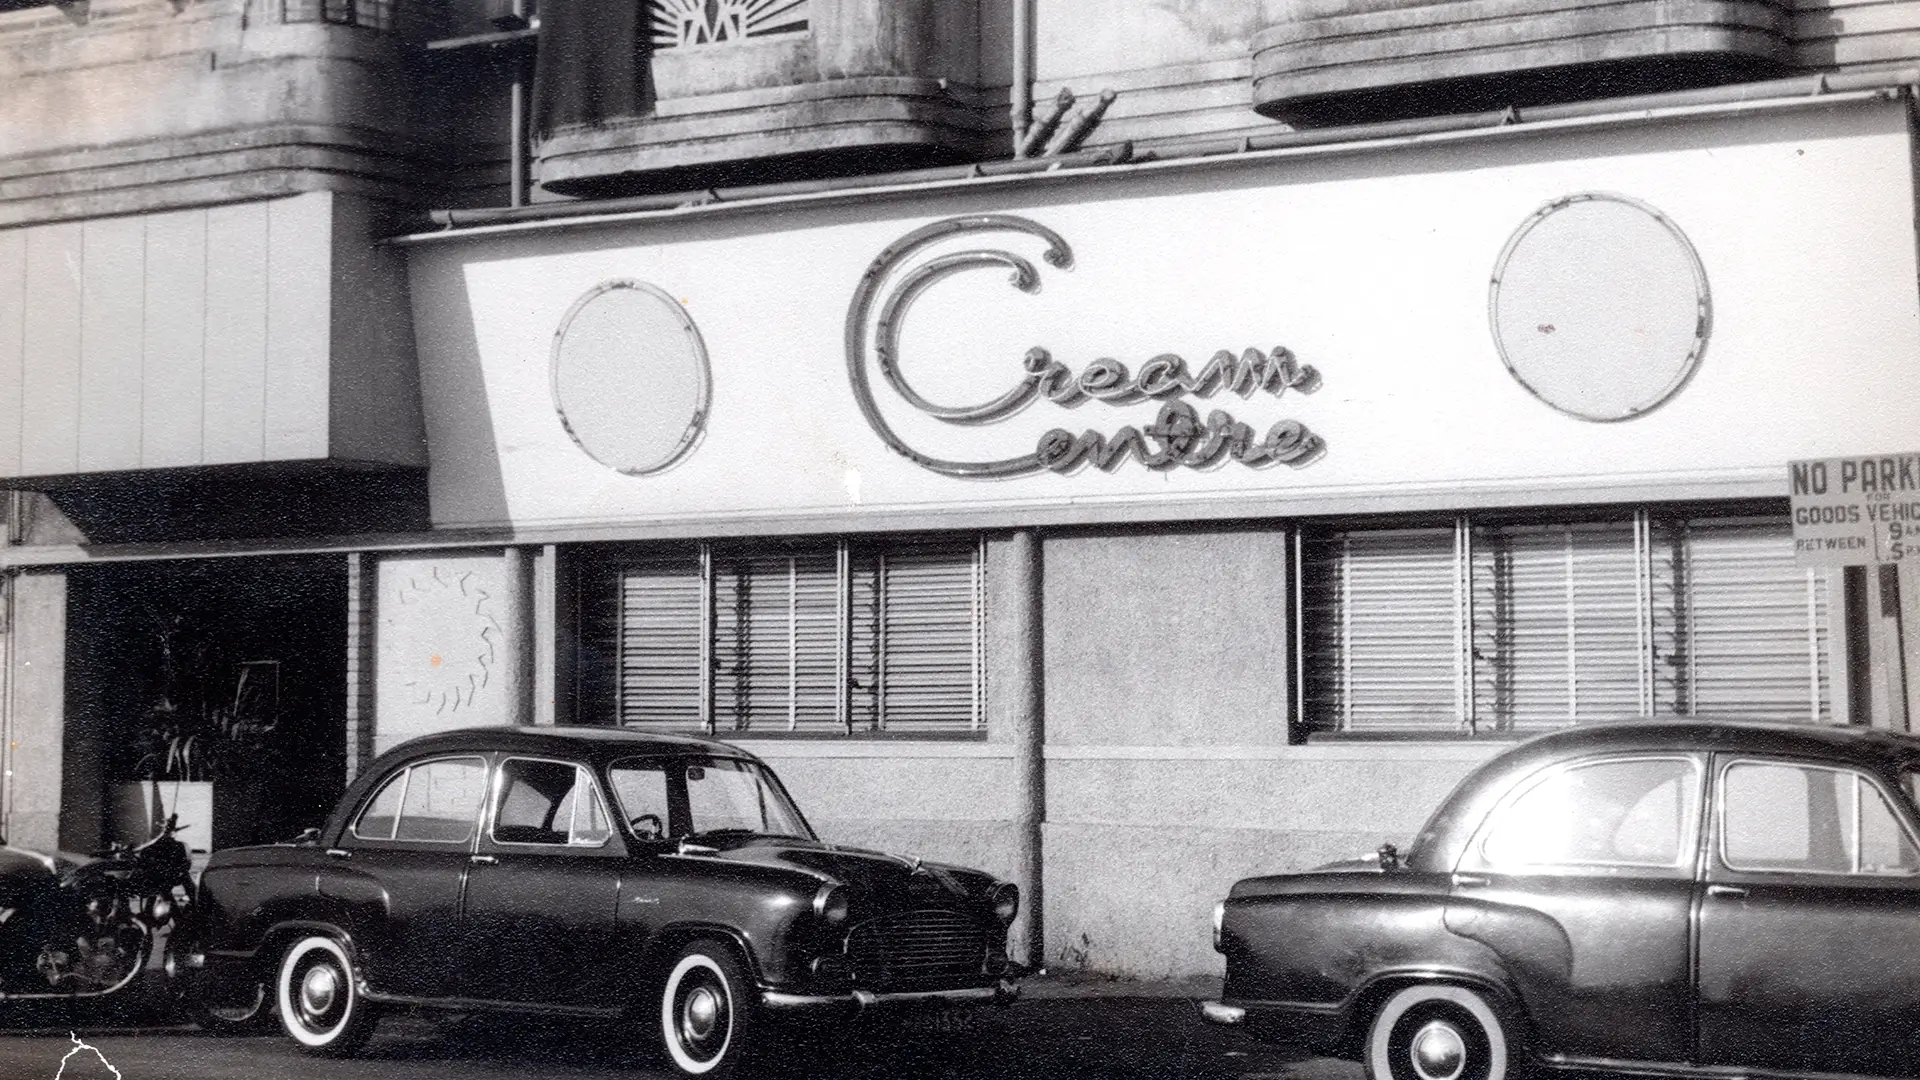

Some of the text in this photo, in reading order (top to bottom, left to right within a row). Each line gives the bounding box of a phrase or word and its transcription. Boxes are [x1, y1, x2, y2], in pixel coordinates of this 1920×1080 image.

[844, 213, 1328, 482] Centre
[874, 248, 1324, 427] Cream
[1792, 457, 1920, 496] NO PARK
[1796, 504, 1861, 526] GOODS
[1795, 536, 1867, 551] BETWEEN
